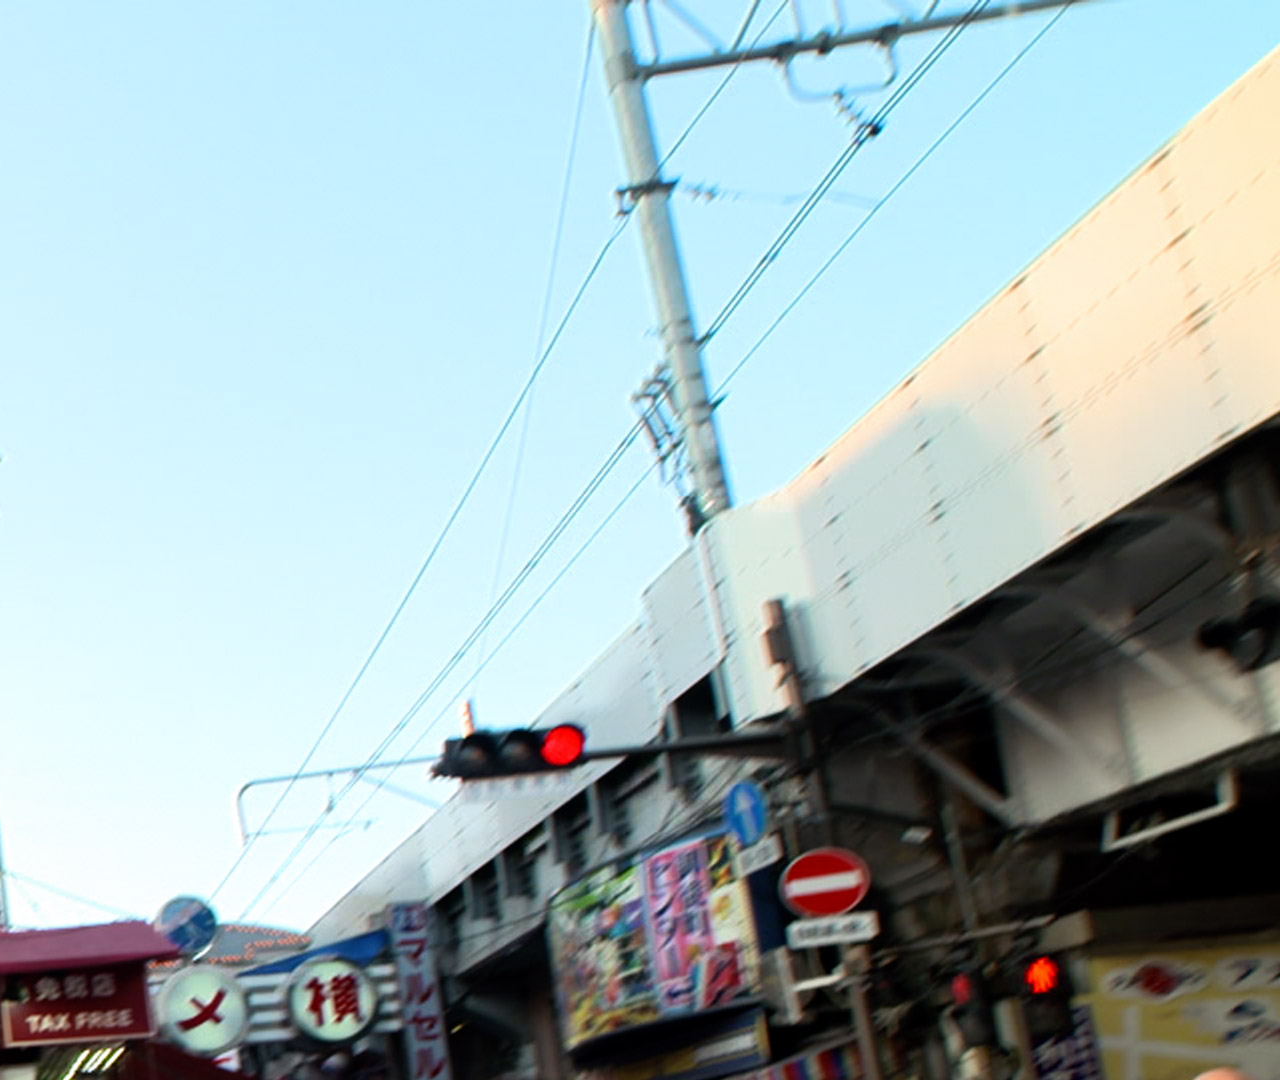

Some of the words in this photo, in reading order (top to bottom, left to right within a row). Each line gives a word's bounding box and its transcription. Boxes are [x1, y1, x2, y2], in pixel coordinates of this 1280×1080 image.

[25, 1011, 71, 1034] TAX
[73, 1008, 134, 1031] FREE
[176, 986, 227, 1032] メ
[305, 974, 364, 1027] 横
